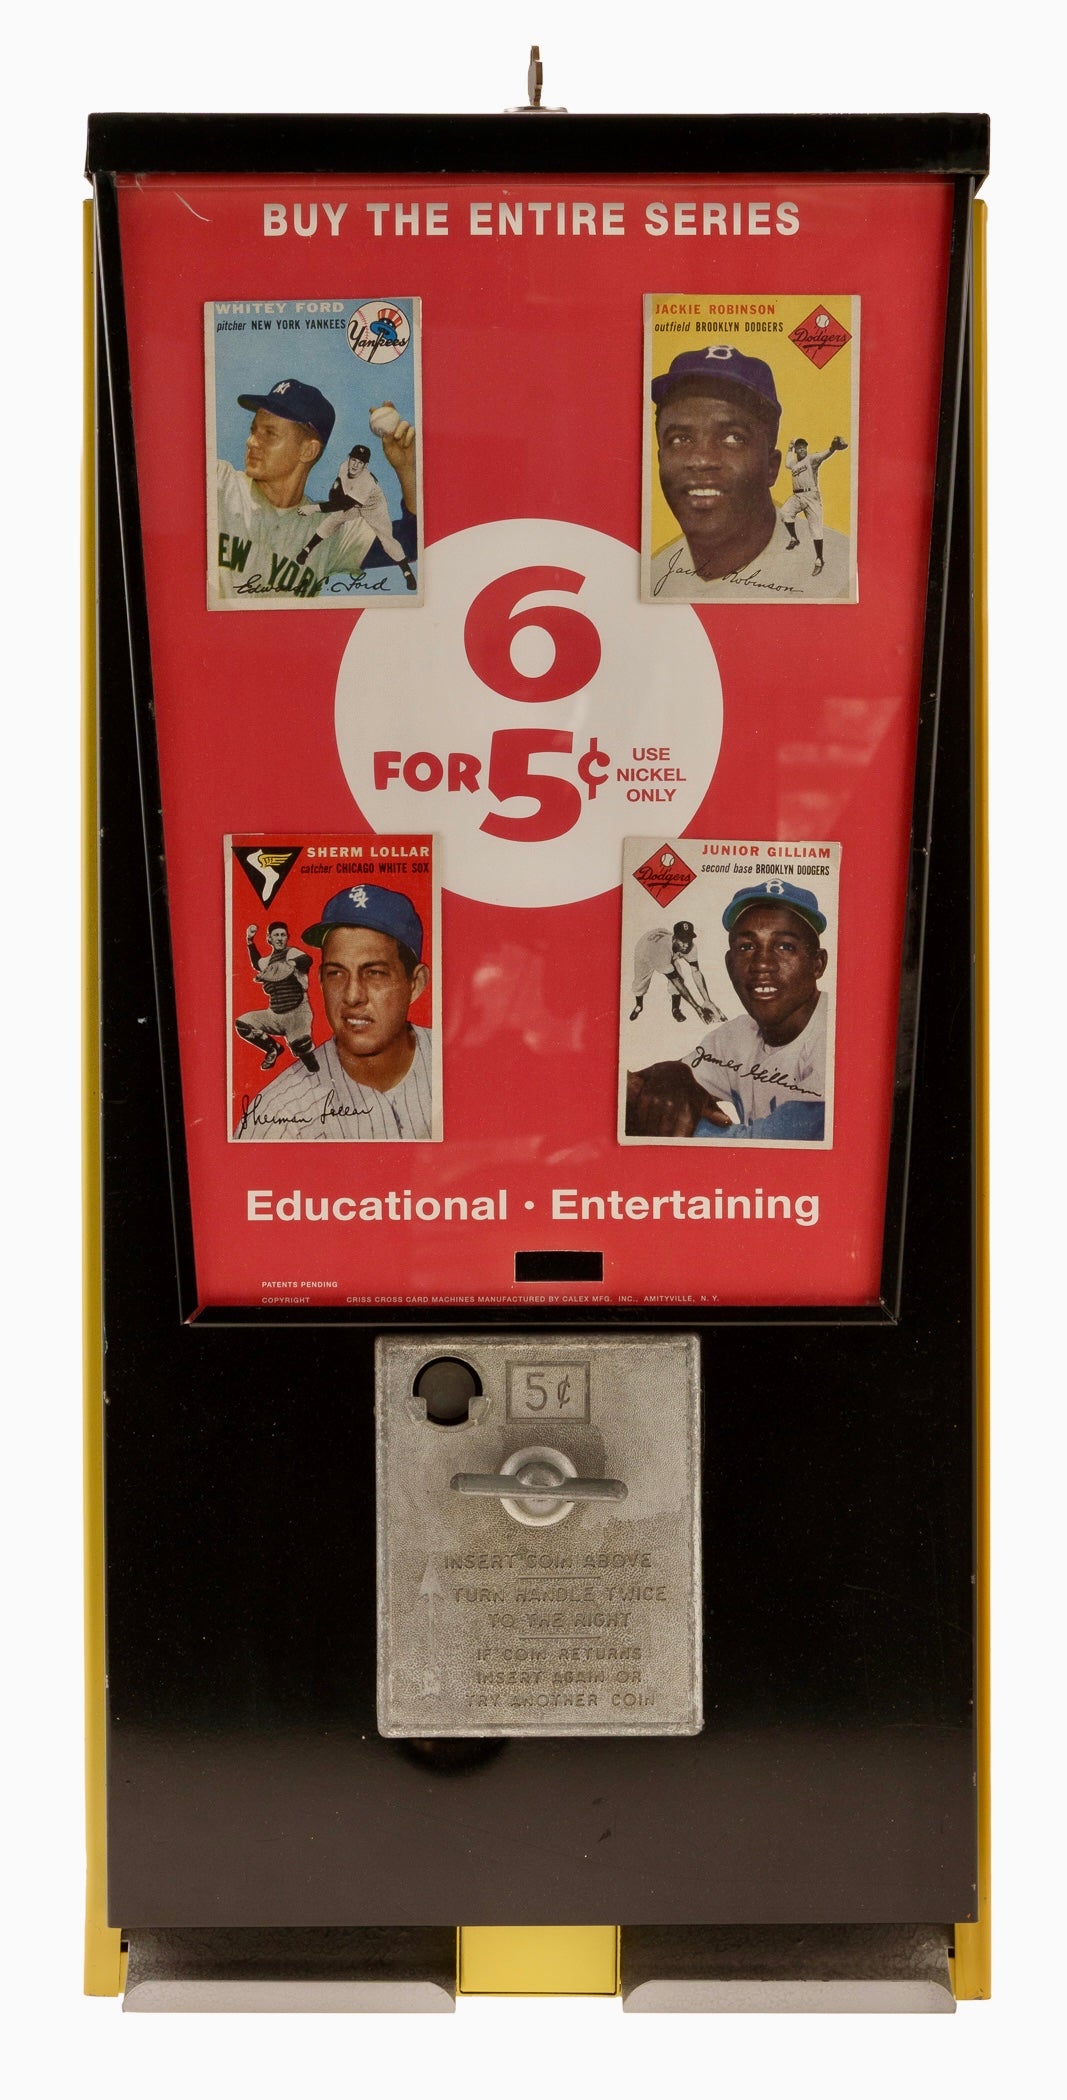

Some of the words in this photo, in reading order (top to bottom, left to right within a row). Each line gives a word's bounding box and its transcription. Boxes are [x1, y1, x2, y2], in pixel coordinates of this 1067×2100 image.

[263, 202, 348, 237] BUY
[366, 202, 449, 236] THE
[470, 202, 625, 236] ENTIRE
[645, 202, 800, 237] SERIES
[216, 303, 287, 315] WHITEY
[295, 302, 345, 314] FORD
[655, 304, 701, 315] JACKIE
[709, 304, 775, 315] ROBINSON
[216, 321, 247, 332] pitcher
[251, 320, 272, 331] NEW
[276, 319, 301, 330] YORK
[305, 319, 346, 330] YANKEES
[654, 321, 691, 332] outfield
[695, 321, 740, 332] BROOKLYN
[744, 321, 784, 333] DODGERS
[348, 320, 408, 363] Yankees
[792, 327, 848, 349] Dodgers
[463, 565, 602, 703] 6
[632, 747, 671, 761] USE
[373, 750, 482, 794] FOR
[616, 767, 687, 782] NICKEL
[626, 788, 677, 802] ONLY
[307, 846, 363, 858] SHERM
[370, 846, 430, 857] LOLLAR
[702, 844, 760, 857] JUNIOR
[767, 847, 831, 859] GILLIAM
[300, 864, 333, 874] catcher
[336, 862, 375, 873] CHICAGO
[379, 863, 407, 873] WHITE
[411, 863, 430, 873] SOX
[701, 863, 730, 873] second
[733, 864, 753, 874] base
[756, 864, 794, 875] BROOKLYN
[797, 865, 830, 876] DODGERS
[637, 865, 692, 888] Dodgers
[246, 1189, 508, 1221] Educational
[551, 1188, 821, 1227] Entertaining
[261, 1296, 310, 1304] COPYRIGHT
[477, 1295, 546, 1303] MANUFACTURED
[548, 1295, 560, 1303] BY
[562, 1295, 589, 1303] CALEX
[591, 1295, 613, 1303] MFG.
[643, 1295, 696, 1303] AMITYVILLE,
[444, 1553, 514, 1569] INSERT
[525, 1553, 572, 1569] COIN
[583, 1553, 652, 1569] ABOVE
[453, 1587, 504, 1602] TURN
[515, 1586, 594, 1602] HANDLE
[607, 1586, 667, 1601] TWICE
[488, 1614, 515, 1628] TO
[526, 1613, 563, 1628] THE
[573, 1612, 632, 1628] RIGHT
[477, 1648, 491, 1661] IF
[503, 1648, 546, 1661] COIN
[559, 1647, 642, 1661] RETURNS
[476, 1671, 542, 1684] INSERT
[552, 1671, 605, 1683] AGAIN
[616, 1671, 642, 1683] OR
[465, 1694, 500, 1707] TRY
[511, 1694, 598, 1707] ANOTHER
[611, 1693, 655, 1706] COIN
